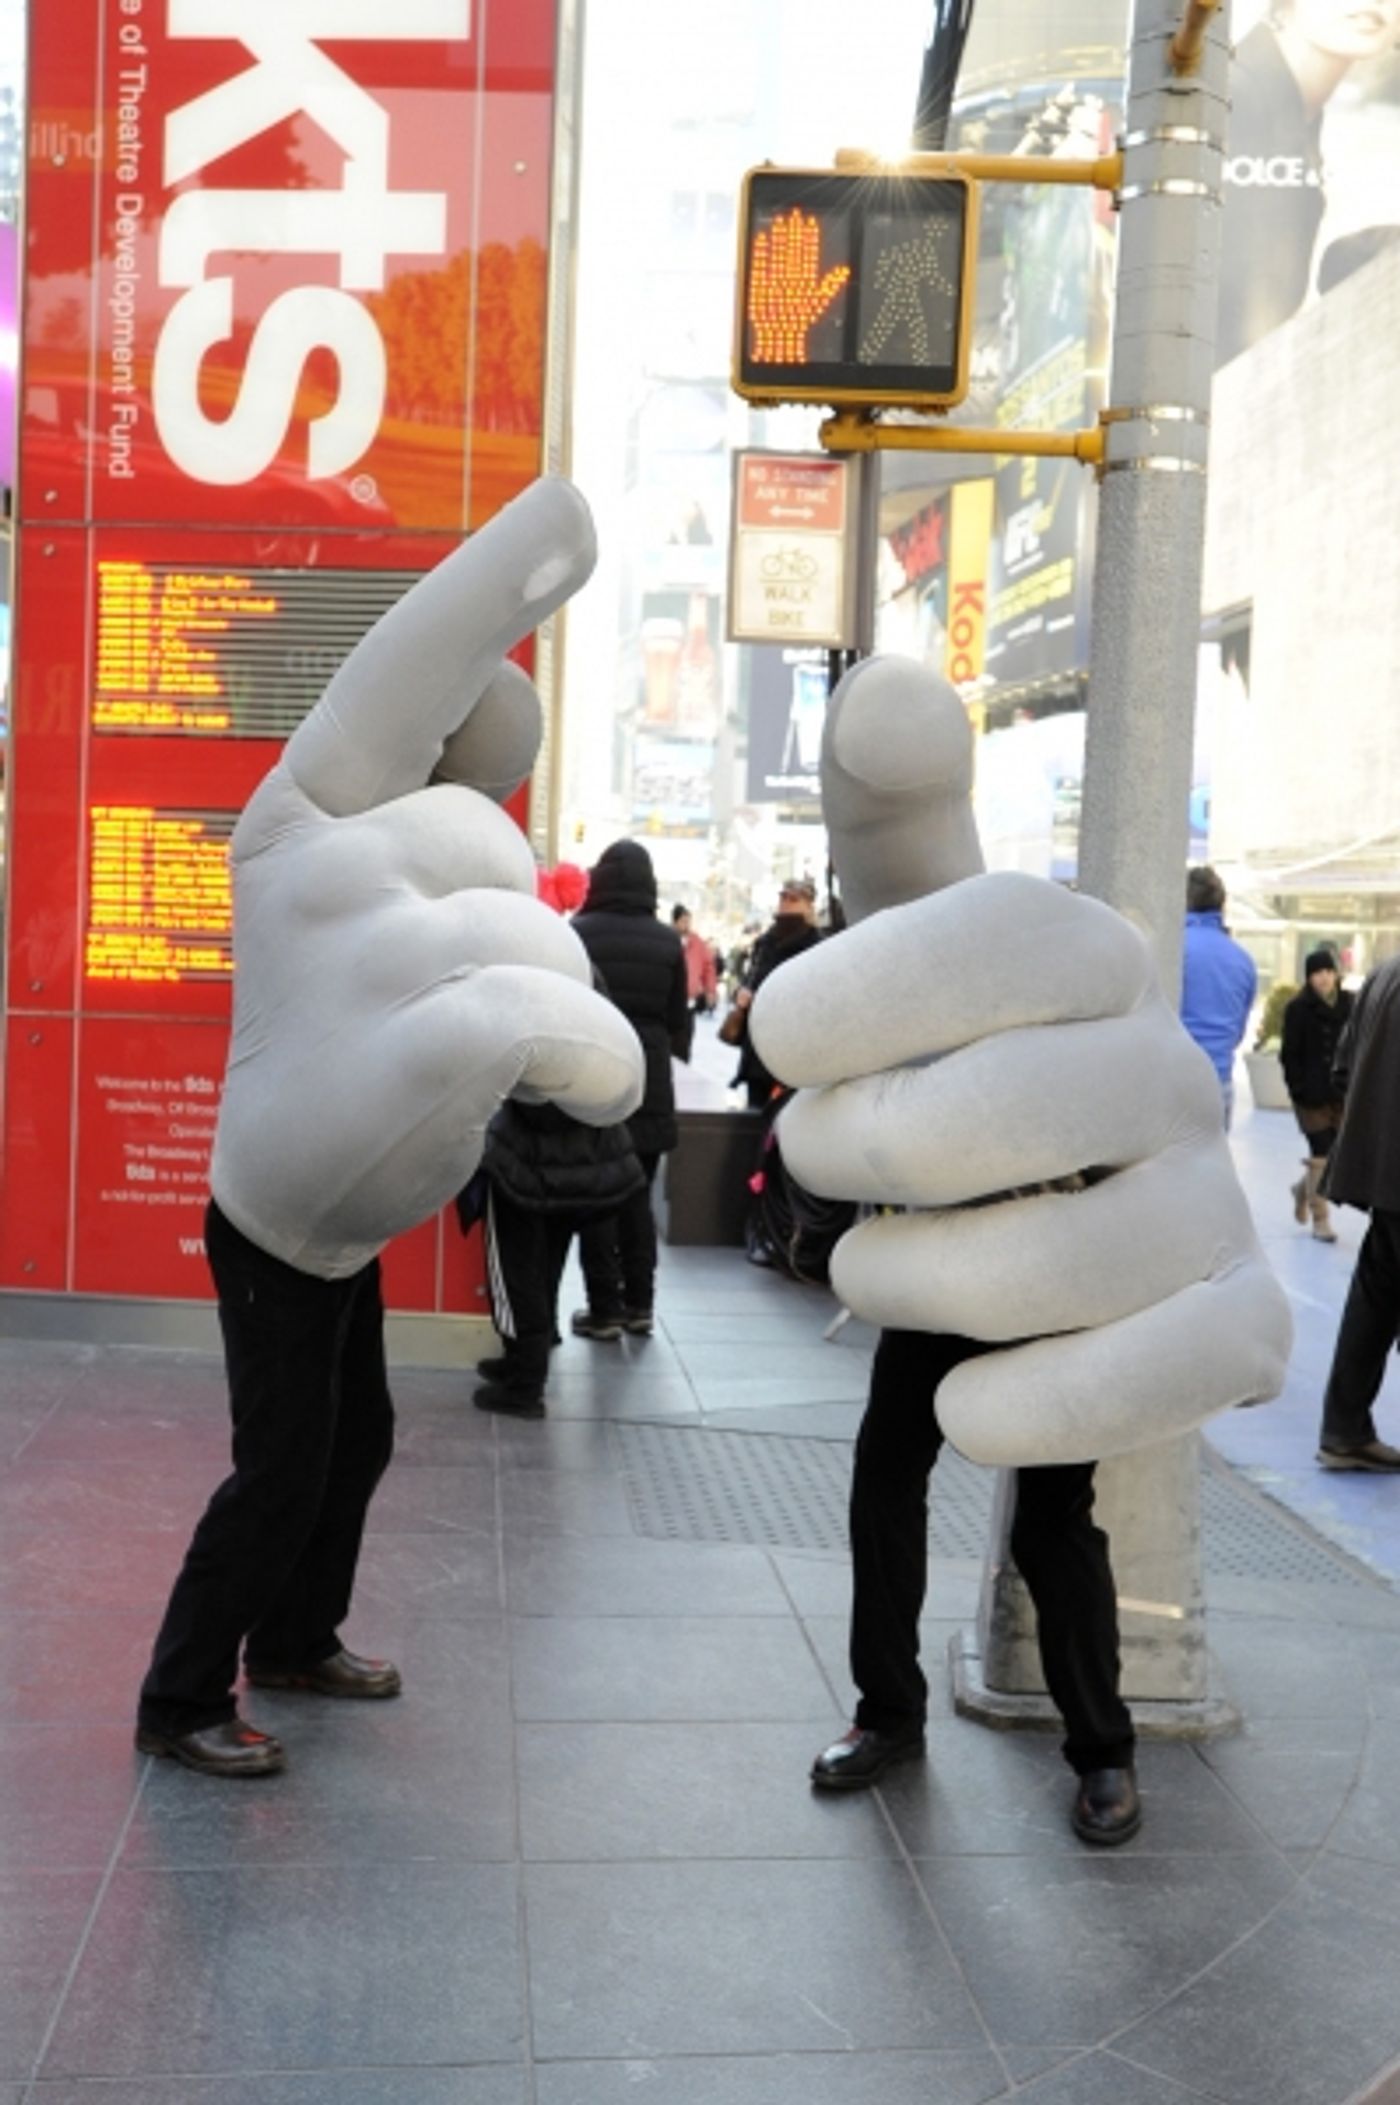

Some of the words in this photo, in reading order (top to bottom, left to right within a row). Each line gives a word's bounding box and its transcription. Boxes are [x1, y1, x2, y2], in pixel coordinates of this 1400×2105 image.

[119, 24, 148, 55] of
[115, 64, 147, 183] Theatre
[109, 193, 143, 394] Development
[108, 403, 138, 479] Fund
[755, 484, 788, 500] ANY
[795, 487, 830, 504] TIME
[764, 586, 812, 603] WALK
[768, 609, 806, 627] BIKE
[950, 580, 984, 686] Kod
[95, 1076, 148, 1090] Welcome
[123, 1144, 145, 1158] The
[147, 1145, 201, 1162] Broadway
